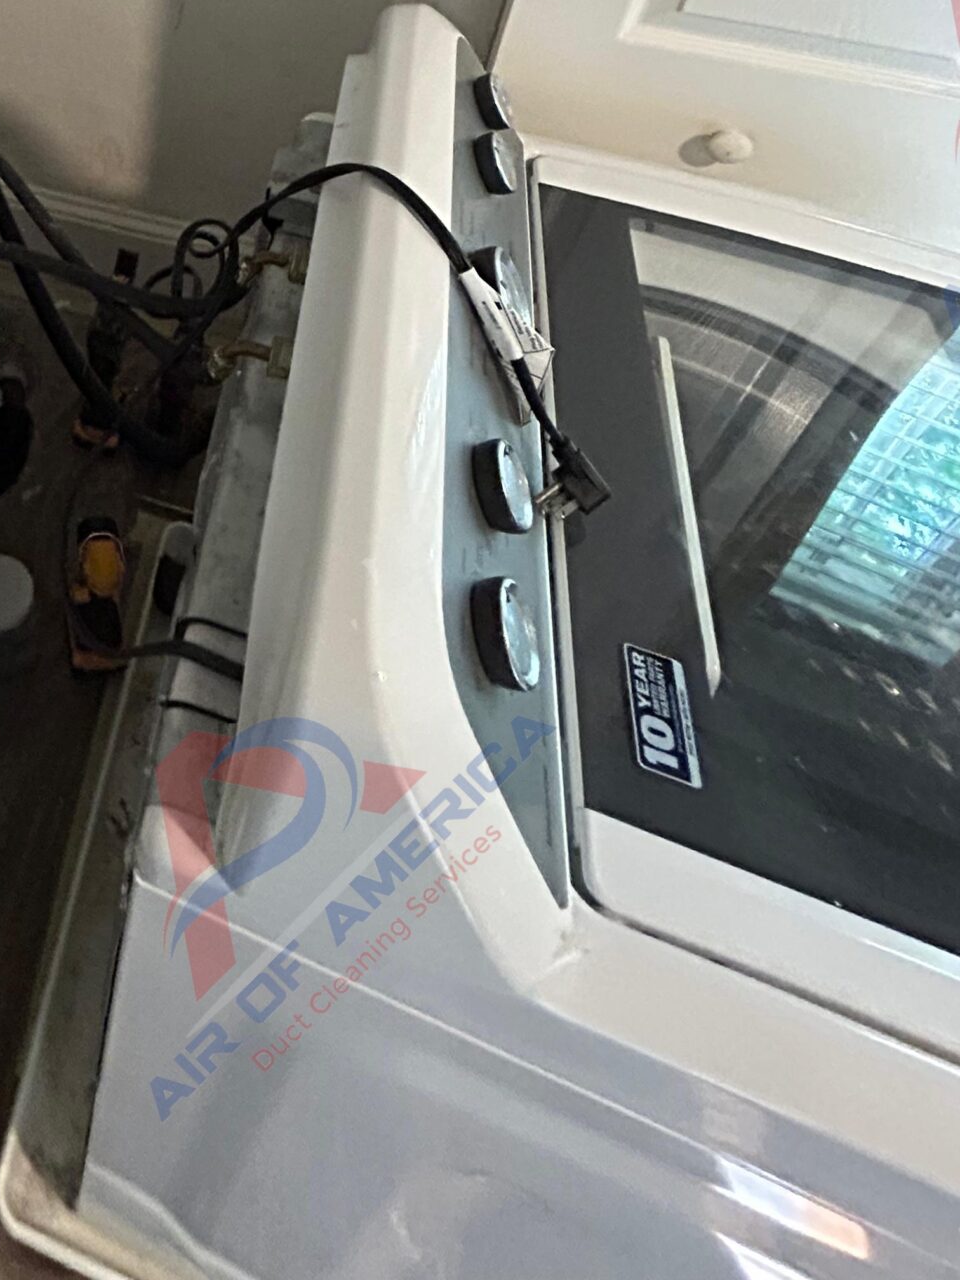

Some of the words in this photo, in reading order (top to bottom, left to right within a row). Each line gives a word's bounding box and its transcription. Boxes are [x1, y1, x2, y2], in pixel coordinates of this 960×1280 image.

[631, 651, 651, 708] YEAR
[654, 659, 670, 718] WARRANTY
[640, 714, 679, 769] 10
